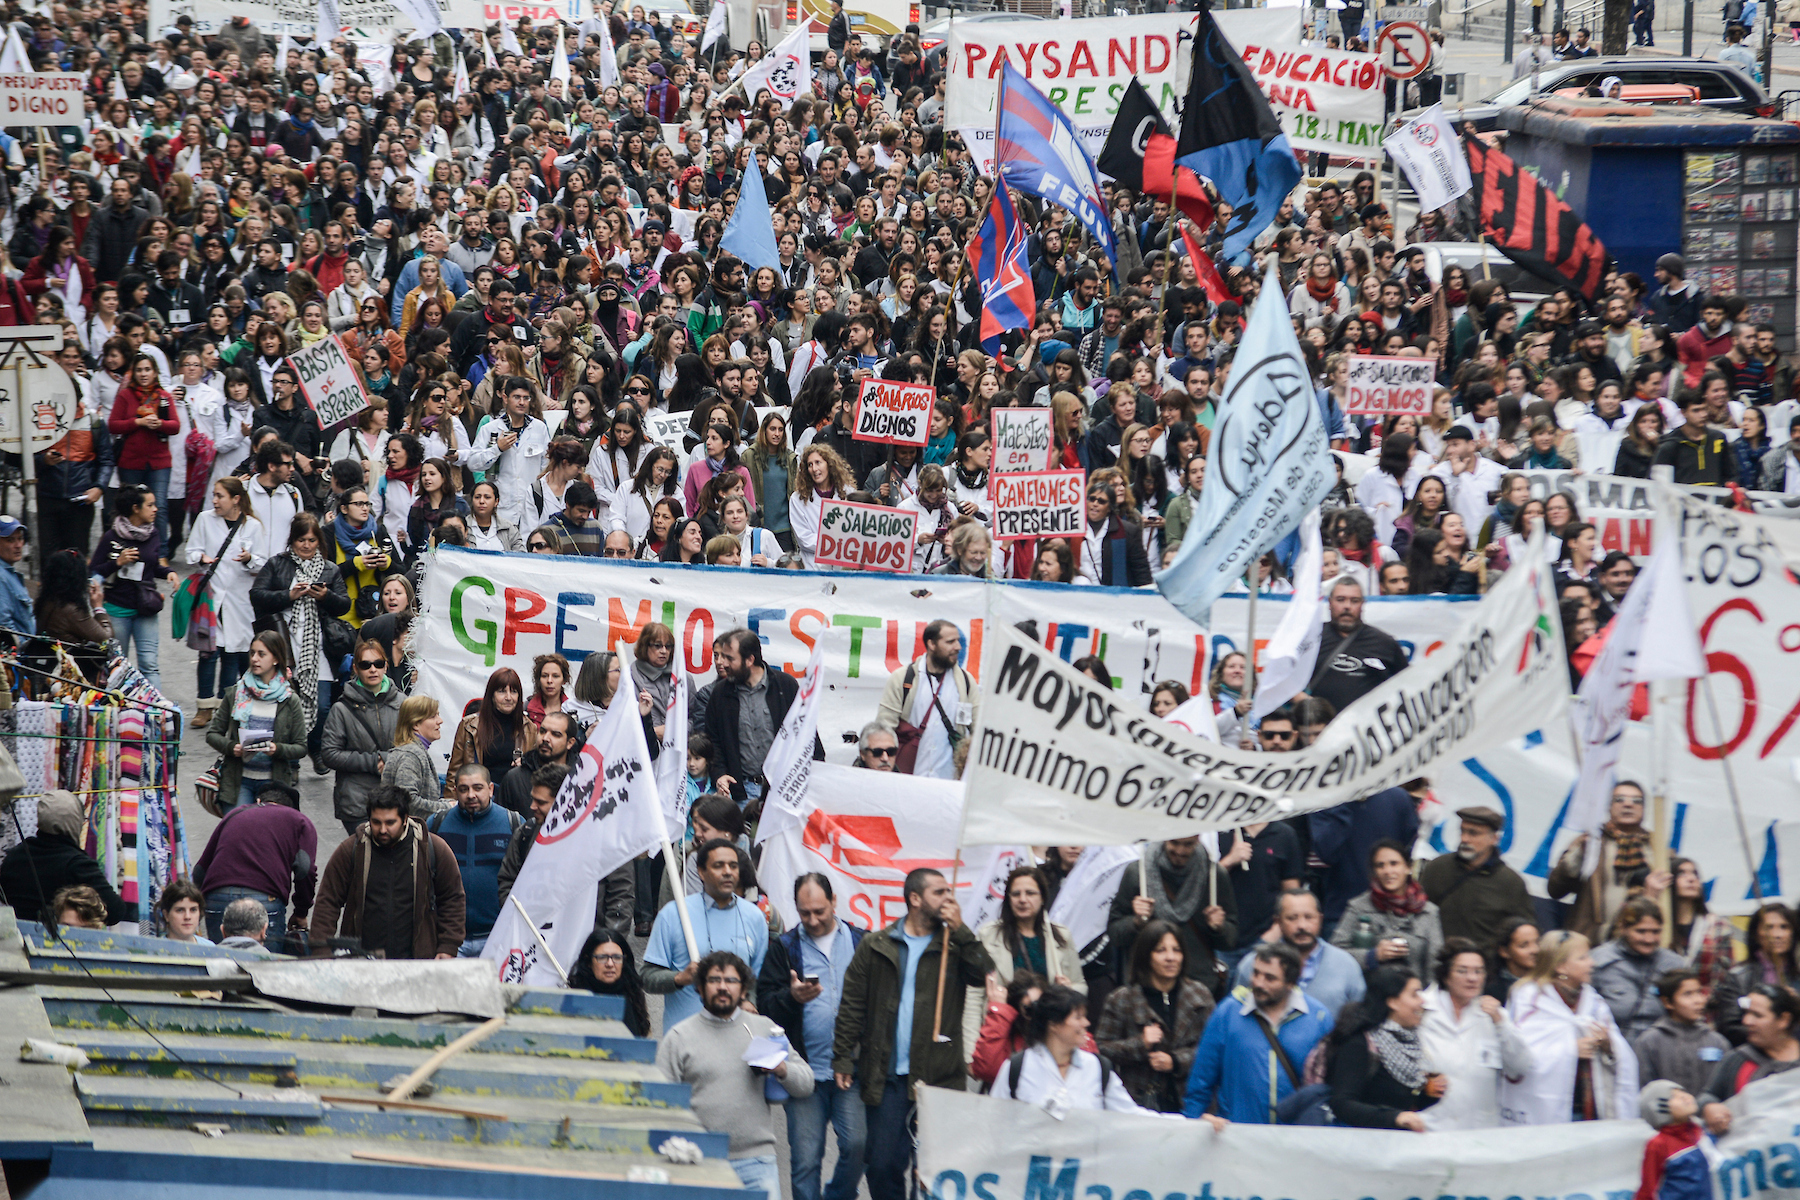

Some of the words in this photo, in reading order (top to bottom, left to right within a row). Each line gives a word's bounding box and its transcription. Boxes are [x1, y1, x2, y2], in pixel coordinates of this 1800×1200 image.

[485, 4, 560, 20] UCHA
[953, 34, 1180, 80] ¡PAYSAND
[0, 76, 83, 91] RESUPUESTO
[1292, 113, 1320, 139] 18
[291, 340, 345, 383] BASTA
[320, 375, 335, 394] DE
[862, 386, 878, 407] POR
[316, 384, 365, 425] ESPERAR
[1349, 386, 1425, 411] DIGNOS
[1008, 451, 1029, 464] en
[995, 476, 1081, 509] CANELONES
[1528, 473, 1578, 504] OS
[822, 507, 844, 530] POR
[997, 506, 1080, 535] PRESENTE
[1114, 763, 1174, 812] 6%
[1166, 782, 1225, 822] del
